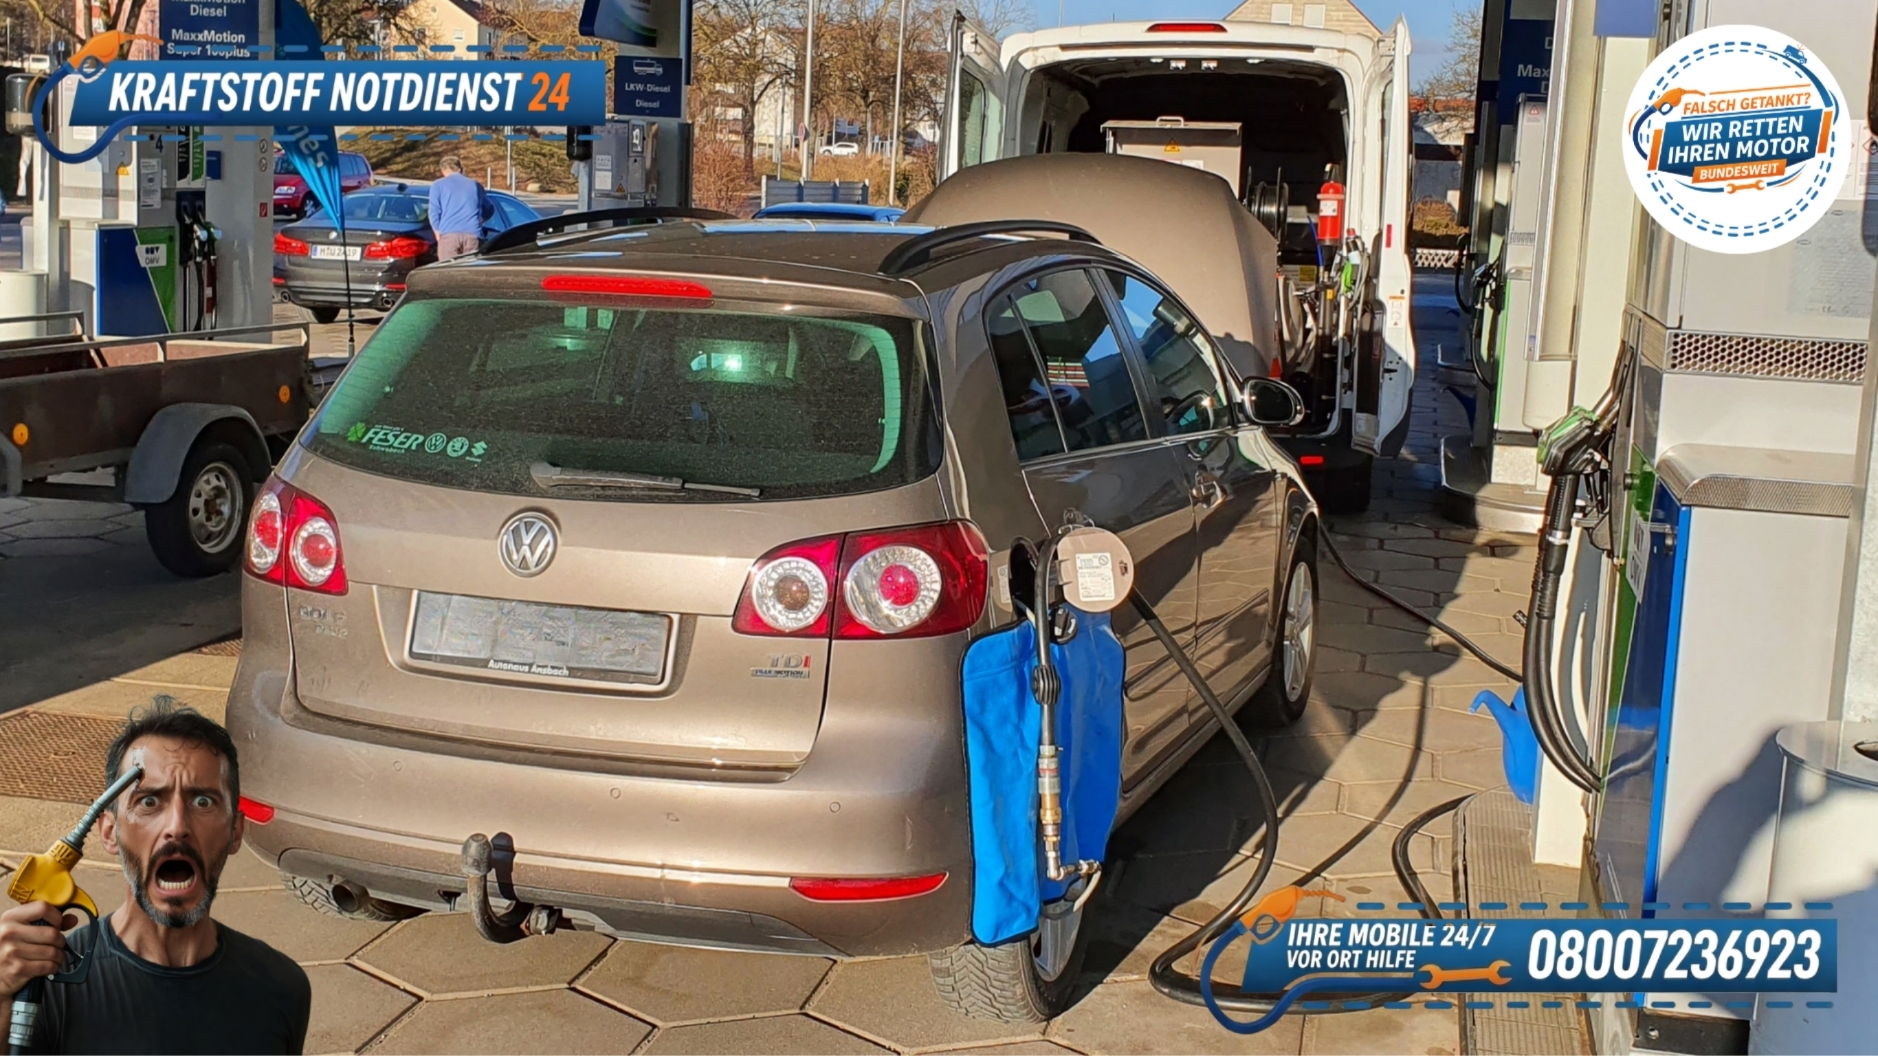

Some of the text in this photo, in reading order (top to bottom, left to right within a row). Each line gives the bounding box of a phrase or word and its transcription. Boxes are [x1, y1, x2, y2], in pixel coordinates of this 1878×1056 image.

[190, 4, 227, 17] Diesel
[171, 29, 246, 43] MaxxMotion
[625, 82, 671, 93] LKW-Diesel
[635, 99, 660, 109] Diesel
[155, 134, 164, 153] 4
[145, 257, 160, 265] OMV
[361, 428, 425, 451] FESER
[767, 654, 811, 668] TDI
[531, 664, 569, 676] Ansbach
